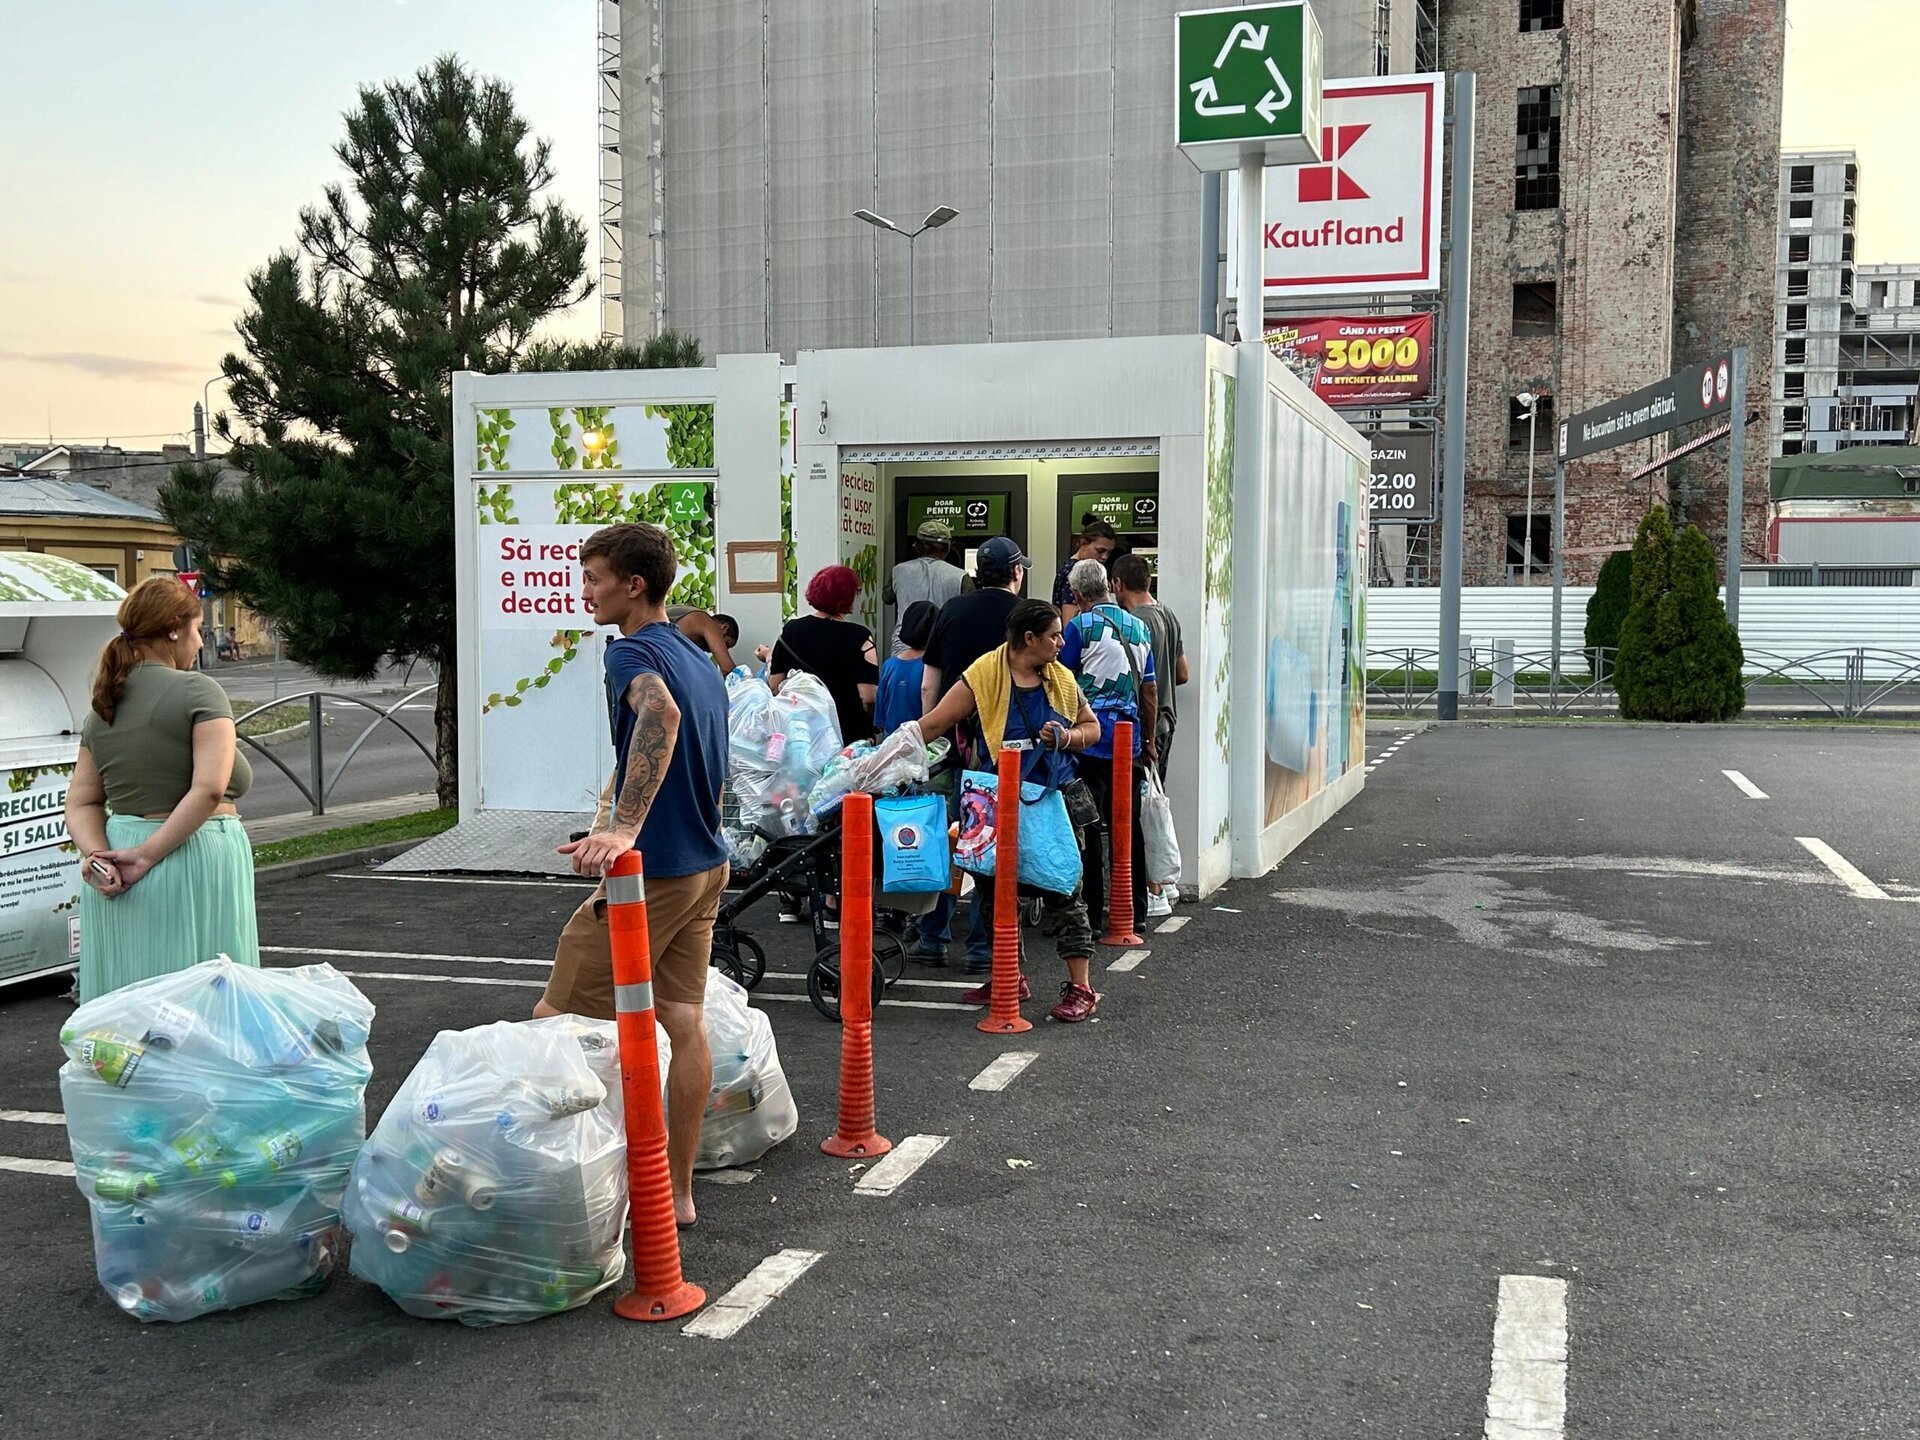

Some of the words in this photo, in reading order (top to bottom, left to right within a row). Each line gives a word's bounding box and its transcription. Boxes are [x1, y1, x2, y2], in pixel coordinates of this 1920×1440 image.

[1264, 216, 1403, 248] Kaufland
[1339, 325, 1364, 335] CÂND
[1366, 326, 1376, 335] AI
[1378, 325, 1406, 334] PESTE
[1324, 337, 1419, 369] 3000
[1321, 376, 1333, 384] DE
[1334, 375, 1376, 384] ETICHETE
[1378, 374, 1418, 383] GALBENE
[1704, 377, 1711, 398] 10
[1583, 423, 1591, 442] Ne
[1624, 410, 1631, 428] te
[1632, 406, 1649, 425] avem
[1650, 392, 1676, 418] alături.
[1370, 473, 1416, 489] 22.00
[854, 501, 872, 517] ușor
[1092, 503, 1129, 511] PENTRU
[1369, 493, 1415, 509] 21.00
[854, 519, 876, 537] crezi.
[1103, 515, 1116, 523] CU
[501, 537, 531, 560] Să
[501, 571, 515, 587] e
[524, 565, 570, 587] mai
[502, 591, 575, 614] decât
[4, 830, 19, 853] ȘI
